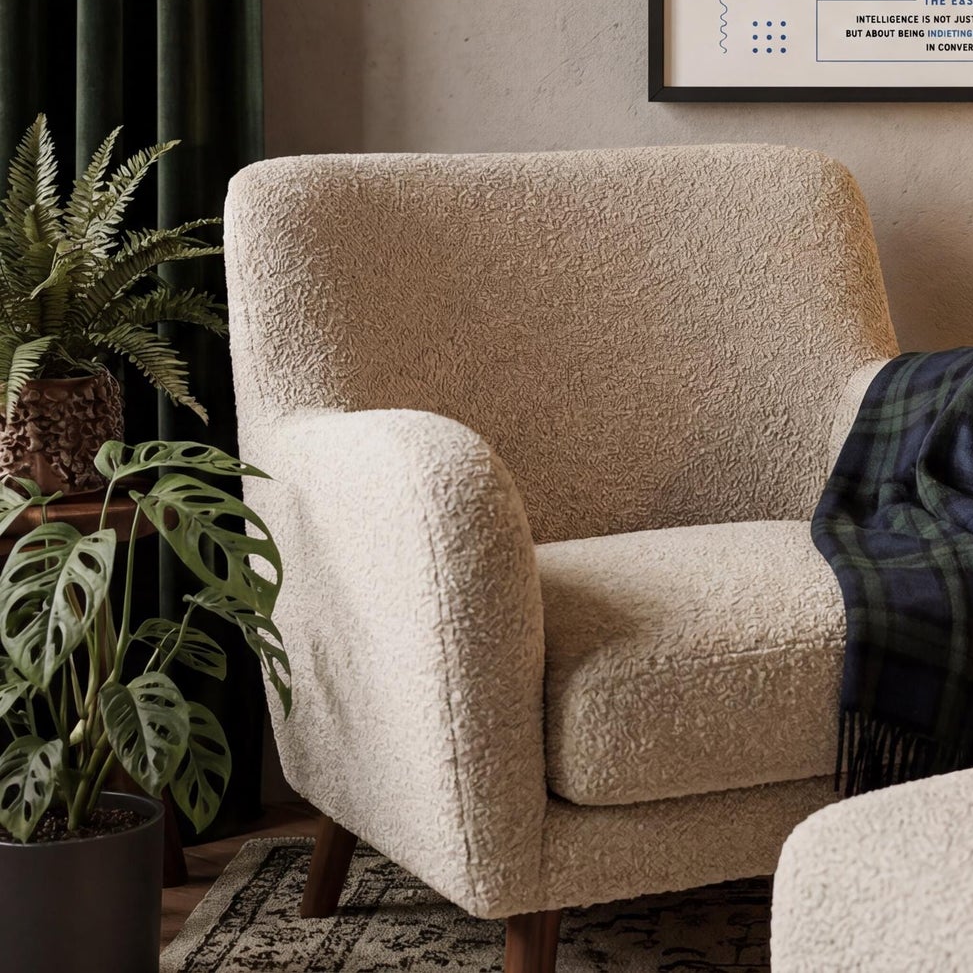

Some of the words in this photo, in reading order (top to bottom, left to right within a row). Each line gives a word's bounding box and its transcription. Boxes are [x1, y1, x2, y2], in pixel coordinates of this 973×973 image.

[856, 14, 919, 24] INTELLIGENCE
[921, 14, 931, 24] IS
[933, 15, 951, 24] NOT
[845, 29, 863, 38] BUT
[865, 29, 896, 38] ABOUT
[897, 29, 925, 38] BEING
[925, 43, 936, 52] IN
